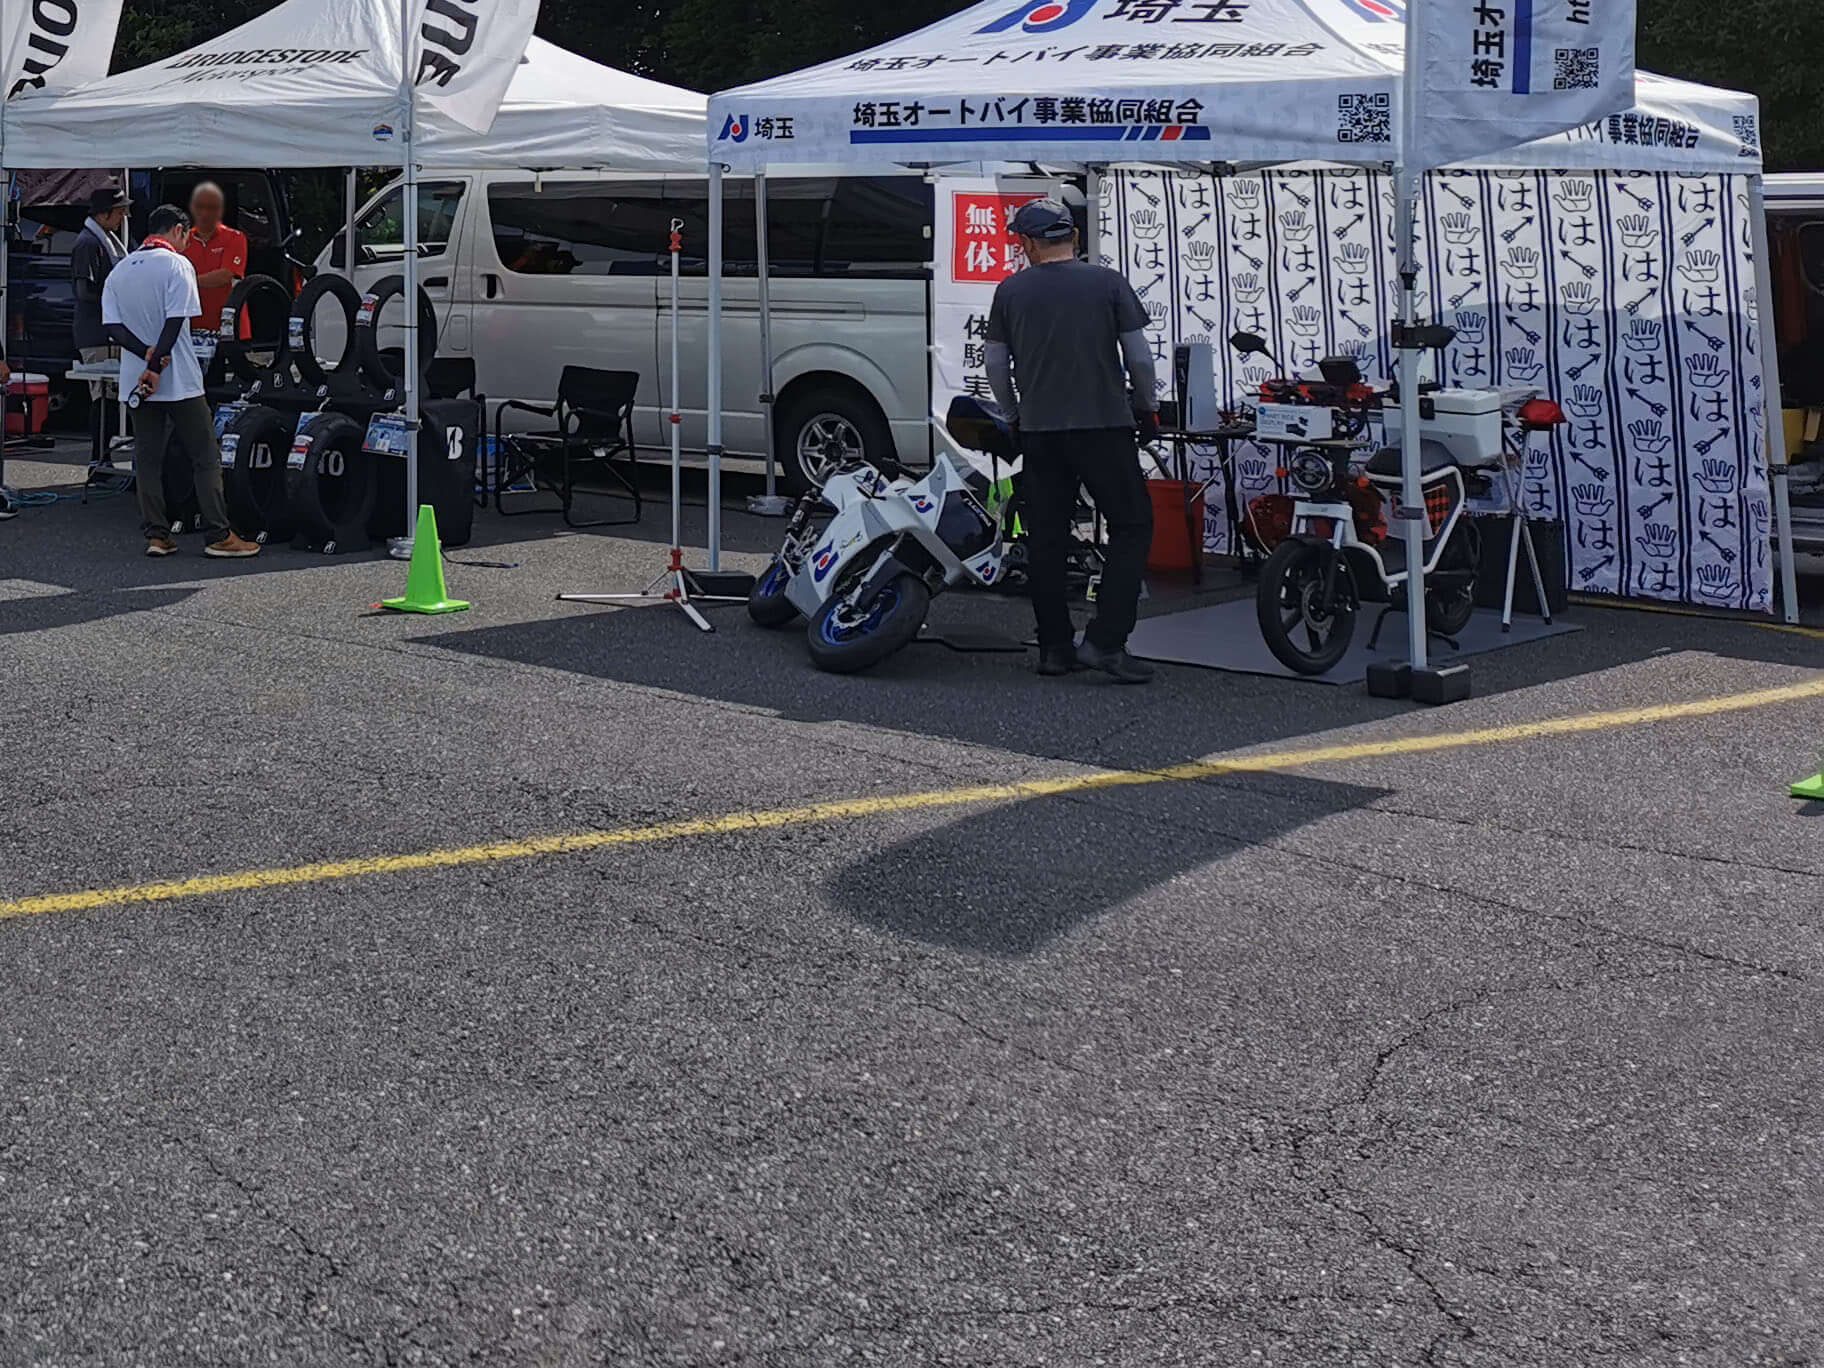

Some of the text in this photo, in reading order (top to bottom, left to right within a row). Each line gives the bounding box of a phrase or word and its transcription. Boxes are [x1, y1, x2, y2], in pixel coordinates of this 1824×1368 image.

[164, 50, 369, 69] BRIDGESTONE
[843, 42, 1325, 72] 埼玉オートバイ事業協同組合
[853, 97, 1205, 126] 埼玉オートバイ事業協同組合
[754, 116, 795, 140] 埼玉
